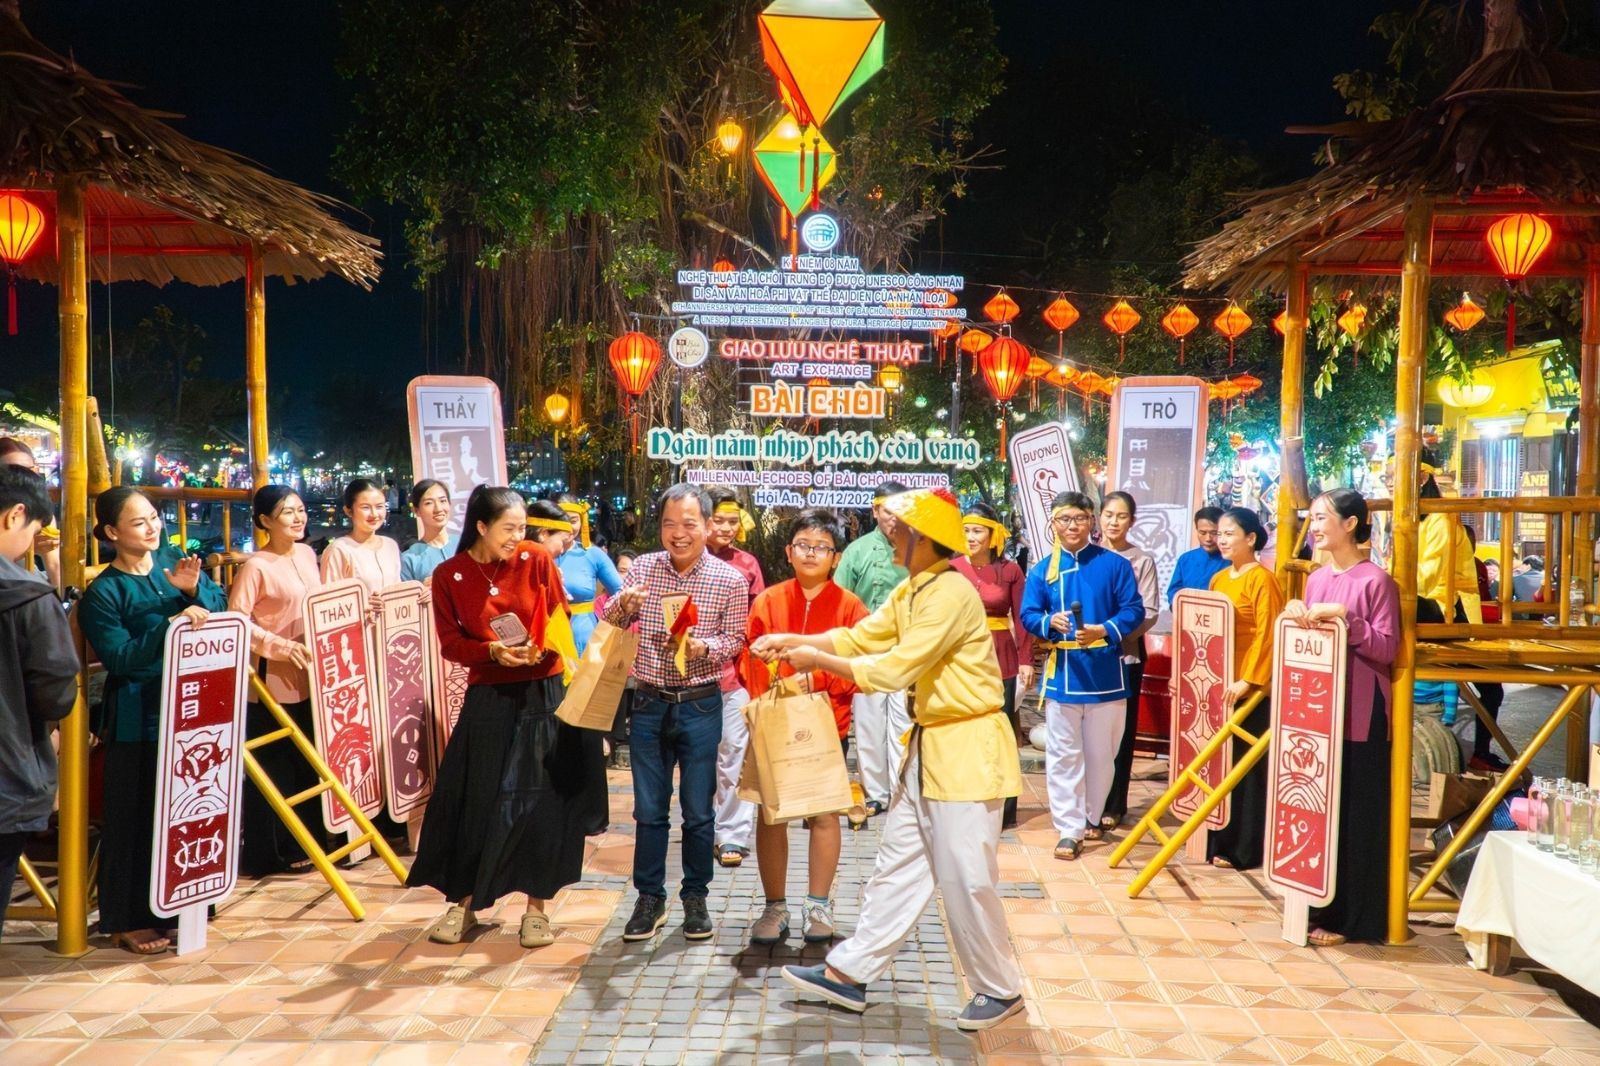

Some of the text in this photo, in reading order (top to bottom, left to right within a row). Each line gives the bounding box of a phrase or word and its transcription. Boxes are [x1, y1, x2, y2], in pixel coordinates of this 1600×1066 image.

[799, 256, 822, 271] NIỆM
[824, 258, 834, 268] 08
[837, 256, 858, 270] NĂM
[679, 271, 705, 286] NGHỆ
[708, 271, 739, 286] THUẬT
[785, 273, 816, 285] TRUNG
[819, 273, 833, 287] BỘ
[835, 274, 865, 288] ĐƯỢC
[867, 276, 905, 287] UNESCO
[908, 273, 934, 287] CÔNG
[936, 275, 962, 290] NHẬN
[694, 288, 704, 298] DI
[772, 289, 787, 300] PHI
[790, 288, 809, 302] VẬT
[832, 290, 848, 304] ĐẠI
[926, 292, 947, 306] LOẠI
[687, 303, 734, 313] ANNIVERSARY
[735, 304, 744, 313] OF
[760, 304, 804, 314] RECOGNITION
[817, 305, 830, 314] THE
[830, 306, 844, 314] ART
[896, 307, 924, 316] CENTRAL
[694, 315, 700, 324] A
[702, 316, 729, 325] UNESCO
[732, 317, 788, 326] REPRESENTATIVE
[868, 319, 899, 327] HERITAGE
[903, 320, 912, 328] OF
[721, 340, 766, 359] GIAO
[769, 340, 806, 360] LƯU
[809, 339, 860, 364] NGHỆ
[863, 340, 923, 366] THUẬT
[772, 364, 870, 377] ART EXCHANGE
[752, 381, 884, 415] BÀI CHÒI
[1142, 397, 1177, 419] TRÒ
[652, 431, 977, 466] Ngàn năm nhịp phách còn vang
[1023, 443, 1059, 463] ĐƯỢNG
[688, 471, 759, 484] MILLENNIAL
[762, 473, 811, 485] ECHOES
[815, 473, 831, 485] OF
[835, 470, 855, 485] BÀI
[891, 475, 948, 487] RHYTHMS
[756, 491, 777, 506] Hội
[782, 491, 803, 505] An,
[320, 603, 353, 624] THÀY
[394, 605, 411, 620] VOI
[1195, 613, 1211, 628] XE
[182, 637, 234, 658] BÒNG
[1294, 635, 1322, 656] ĐÁU
